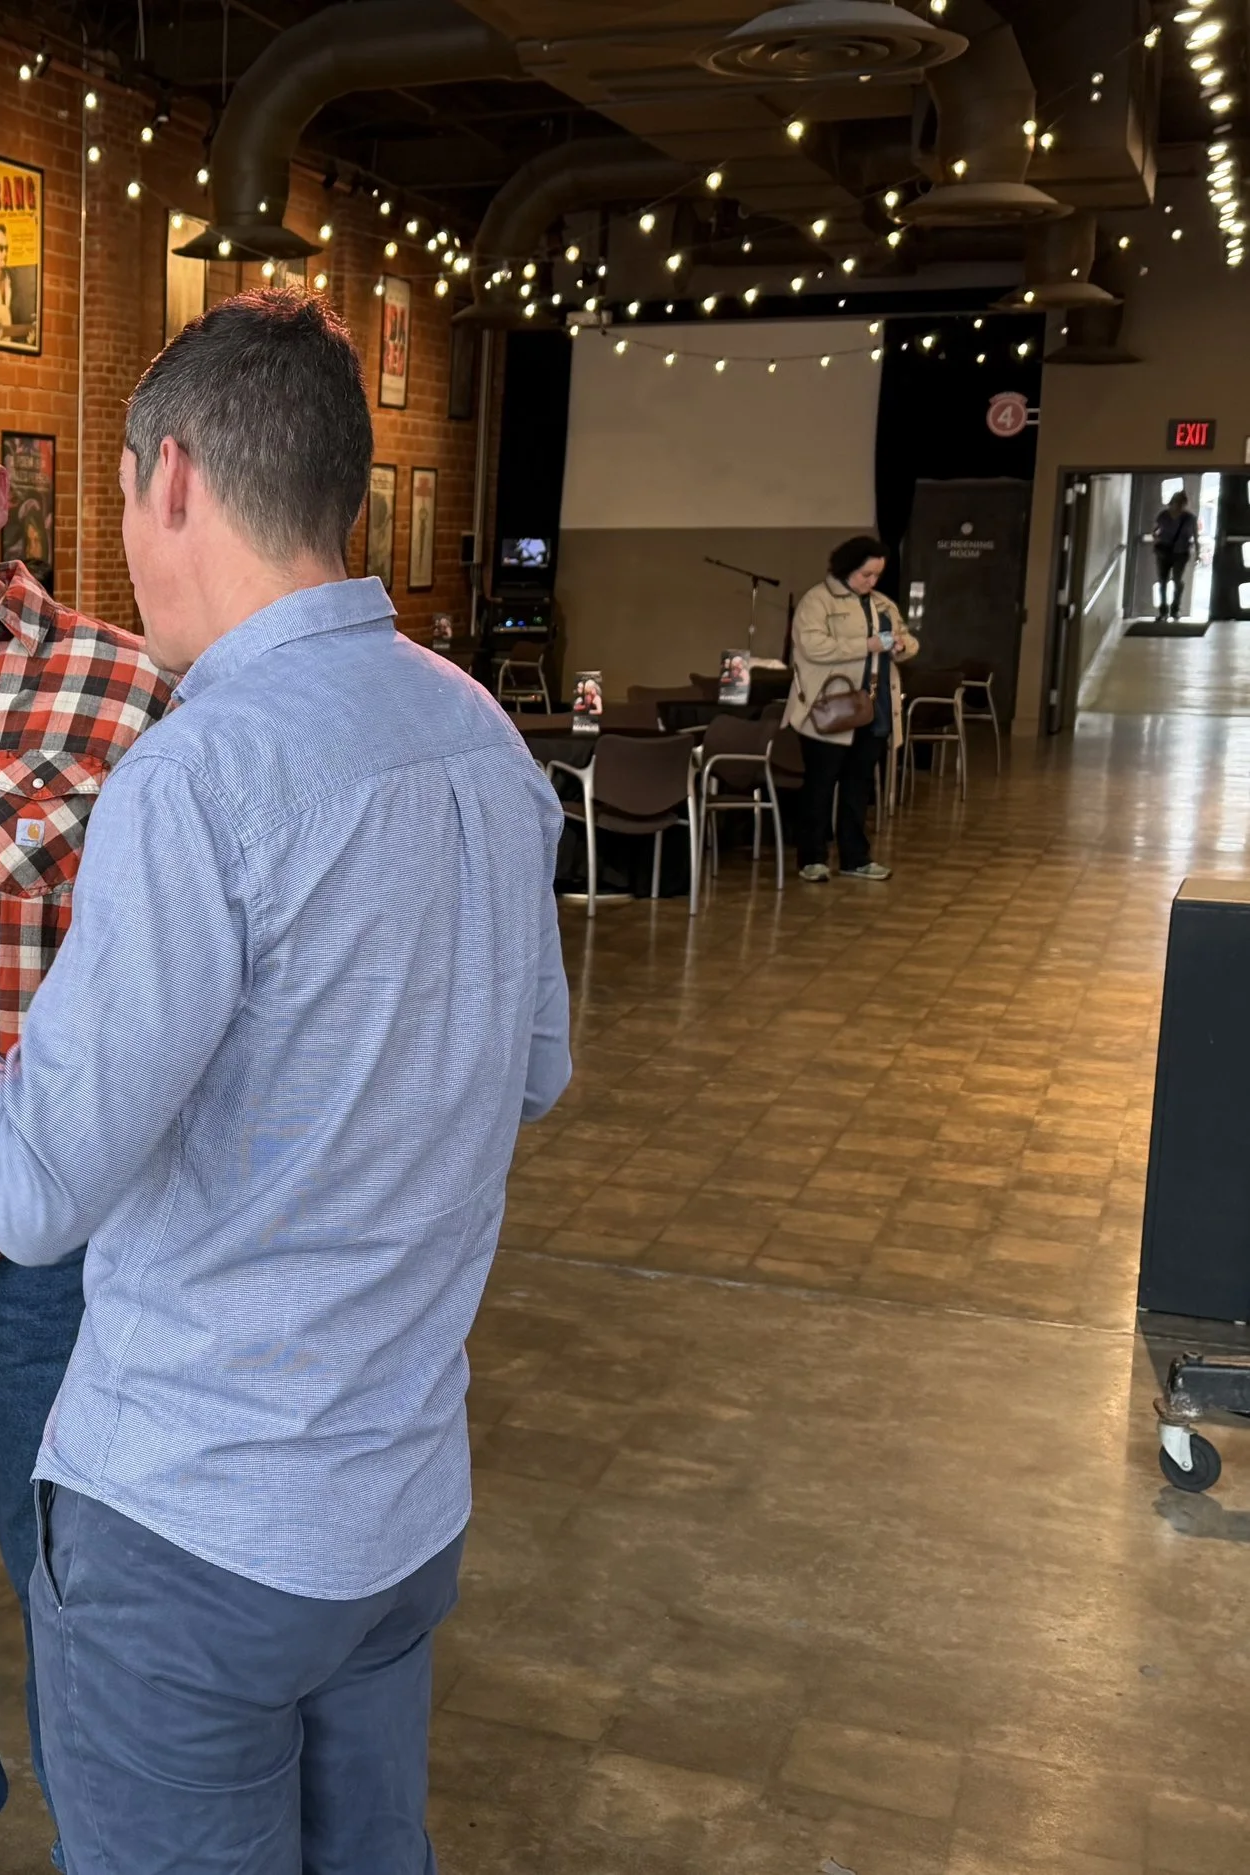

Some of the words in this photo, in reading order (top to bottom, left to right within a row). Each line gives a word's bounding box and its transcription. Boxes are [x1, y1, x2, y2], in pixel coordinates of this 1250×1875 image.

[997, 405, 1015, 429] 4
[1175, 423, 1209, 446] EXIT
[936, 540, 994, 550] SCREENING
